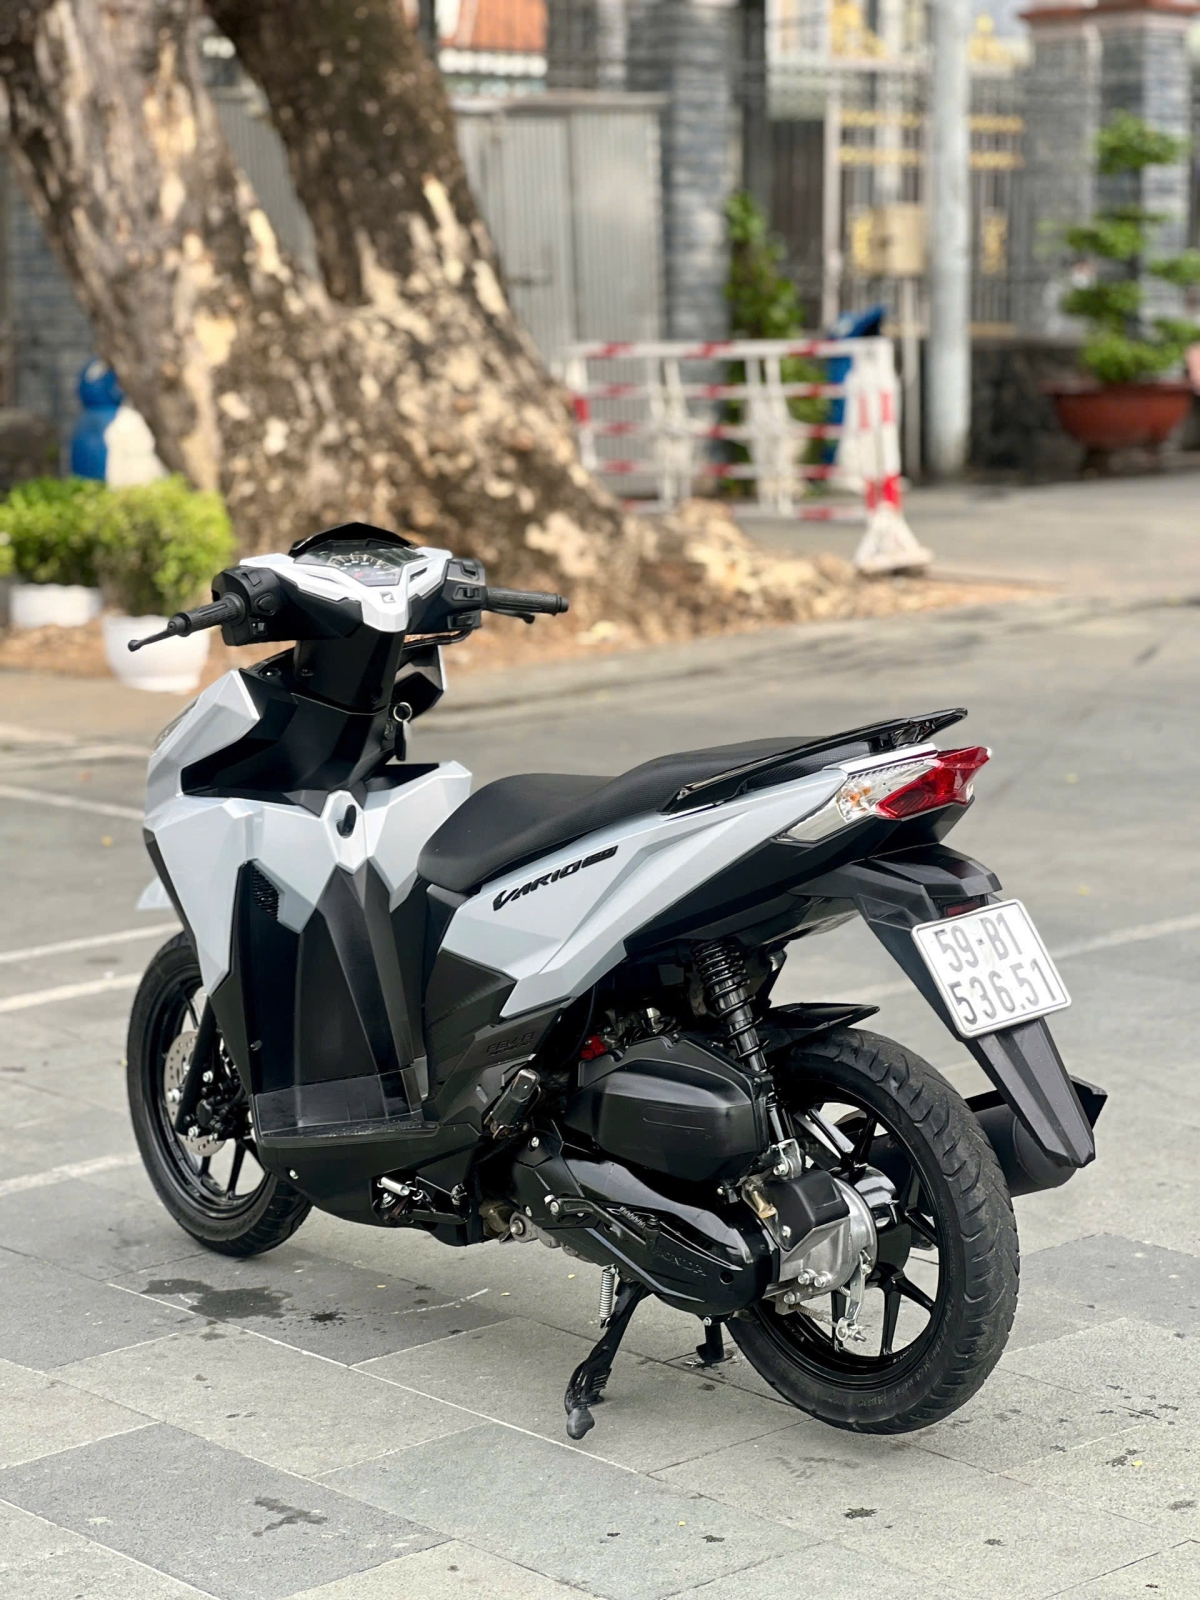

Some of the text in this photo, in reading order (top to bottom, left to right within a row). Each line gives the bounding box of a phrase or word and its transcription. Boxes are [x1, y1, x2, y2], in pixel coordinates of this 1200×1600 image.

[493, 860, 582, 911] VARIO
[934, 912, 1023, 973] 59-B1
[947, 958, 1057, 1025] 536.51
